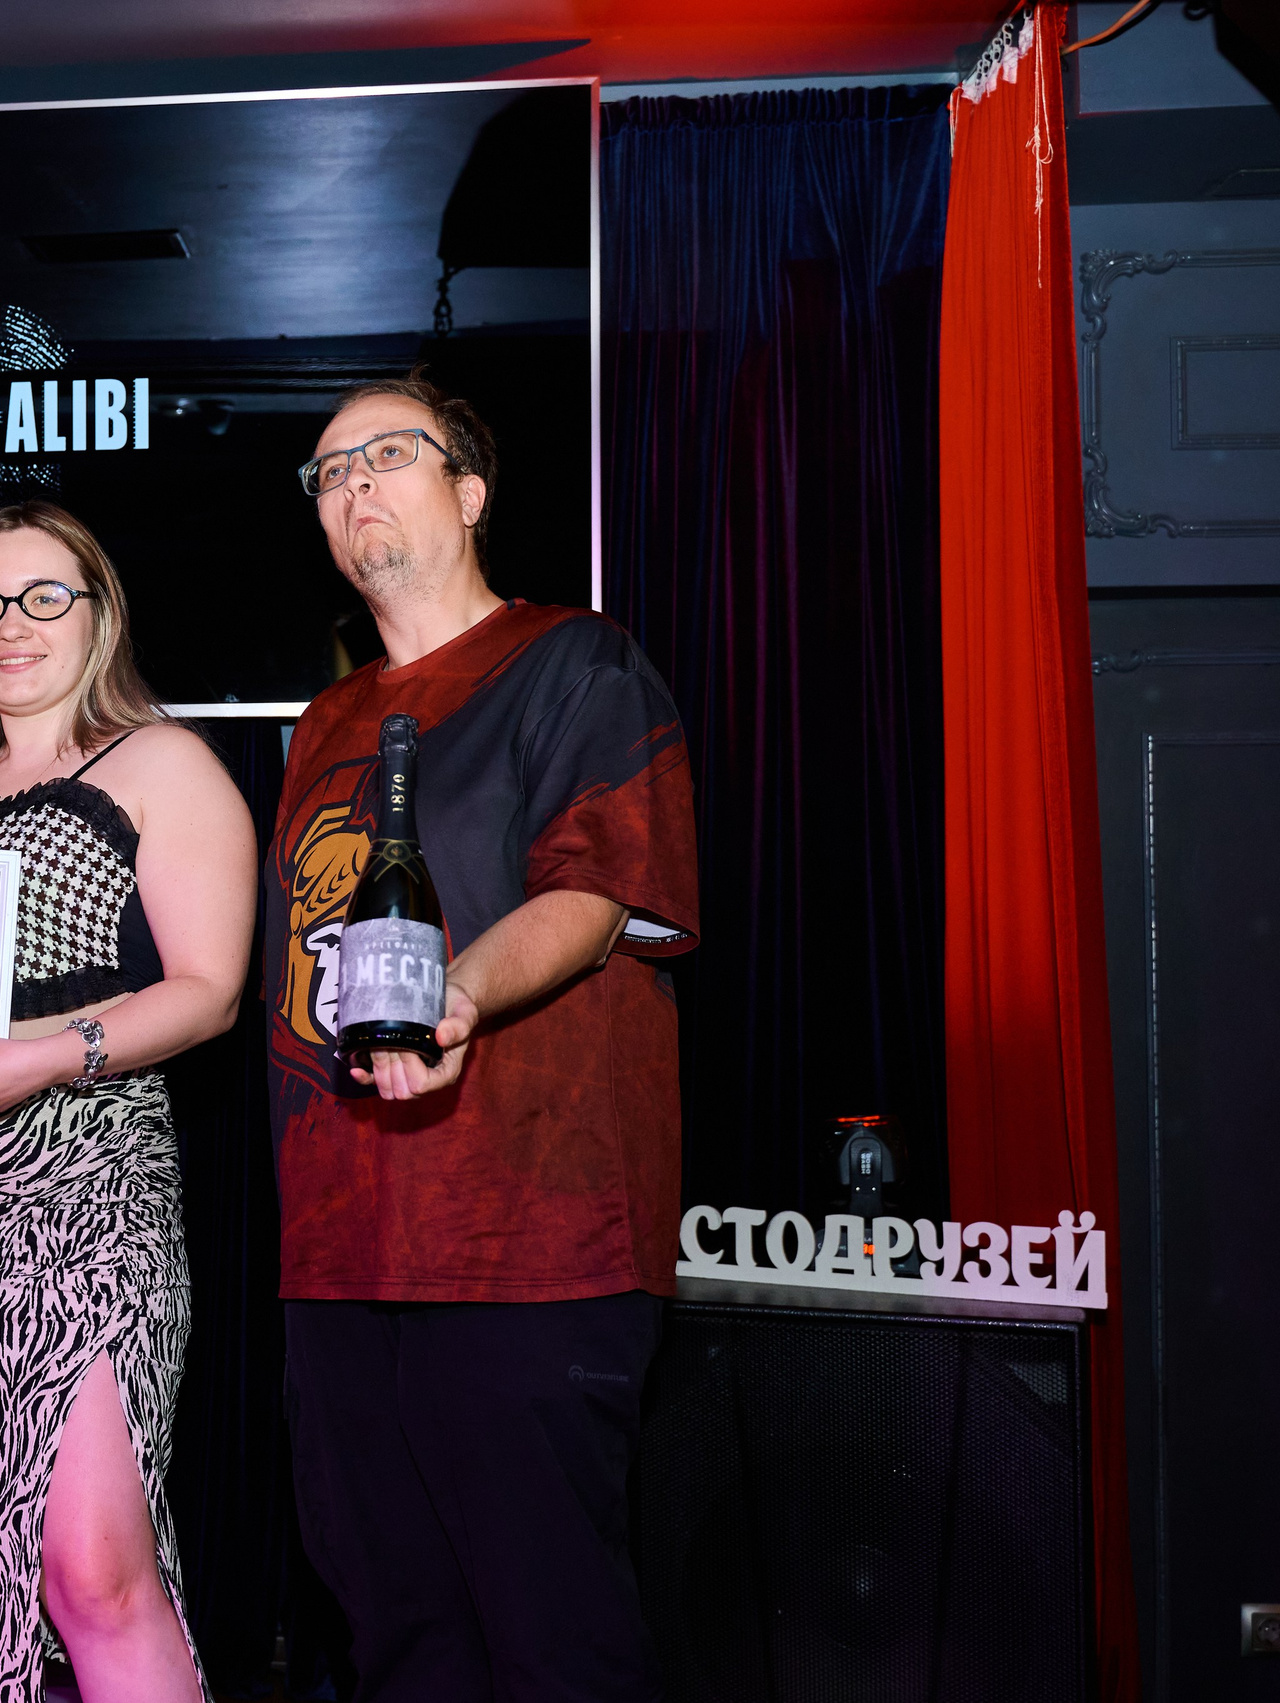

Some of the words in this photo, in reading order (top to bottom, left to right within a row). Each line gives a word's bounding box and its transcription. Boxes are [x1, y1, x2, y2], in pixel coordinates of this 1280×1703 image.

[4, 378, 150, 453] ALIBI
[391, 773, 406, 813] 1870
[356, 953, 444, 998] МЕСТО
